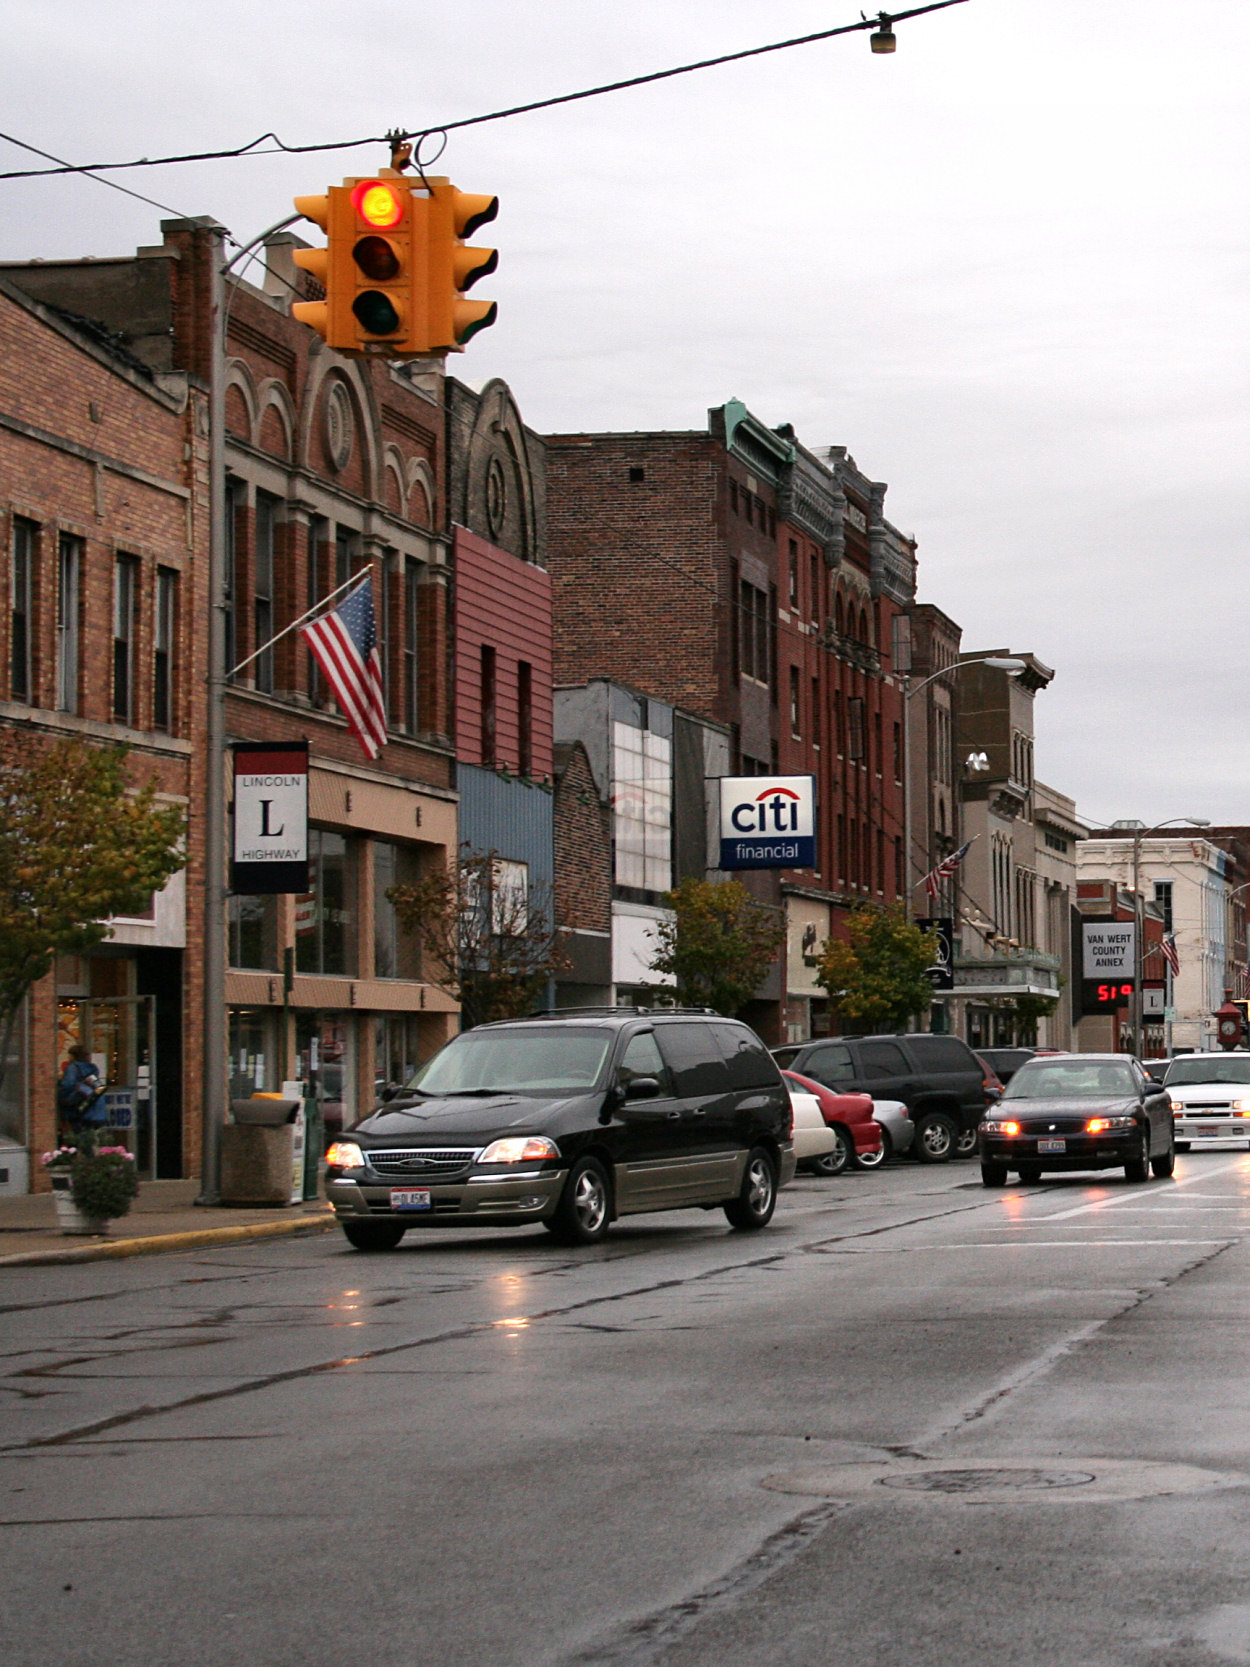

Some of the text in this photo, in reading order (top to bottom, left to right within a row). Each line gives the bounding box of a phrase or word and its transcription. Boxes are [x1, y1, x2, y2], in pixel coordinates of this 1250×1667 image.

[242, 776, 300, 787] LINCOLN
[258, 800, 285, 837] L
[731, 794, 798, 832] citi
[242, 850, 300, 860] HIGHWAY
[736, 843, 799, 859] financial
[1087, 934, 1132, 943] VAN WERT
[1092, 946, 1126, 955] COUNTY
[1095, 958, 1124, 967] ANNEX
[1150, 995, 1158, 1008] L
